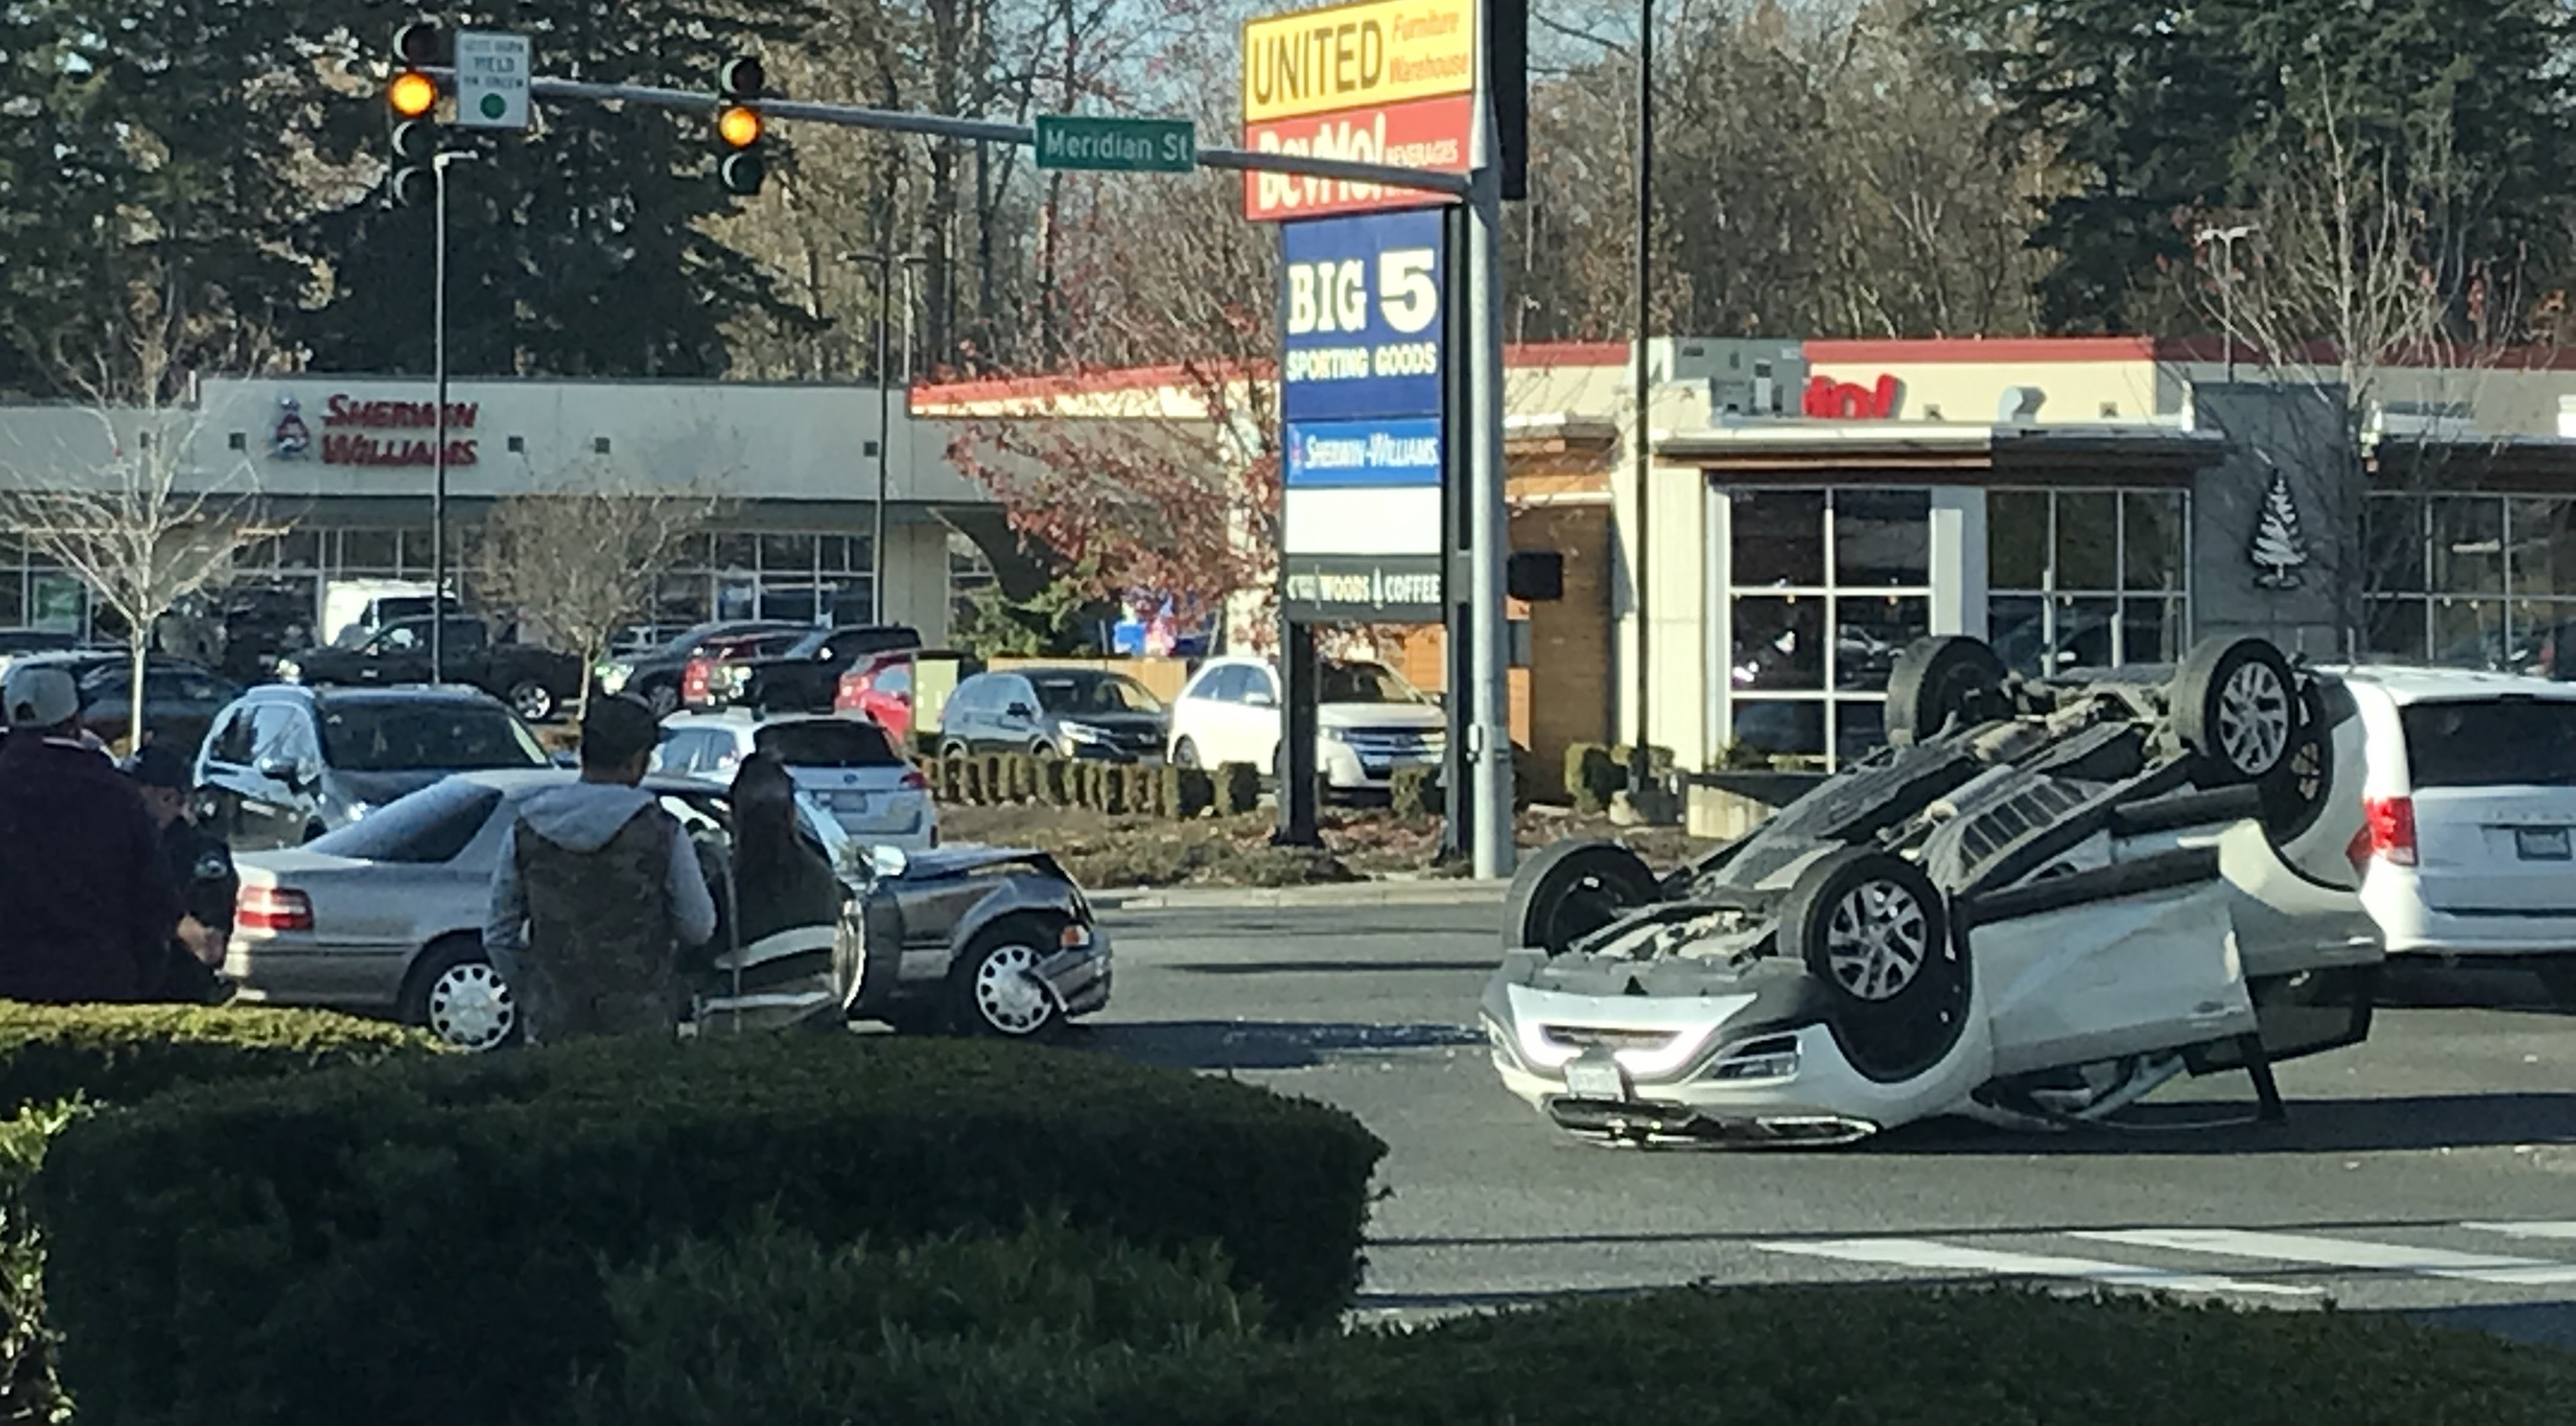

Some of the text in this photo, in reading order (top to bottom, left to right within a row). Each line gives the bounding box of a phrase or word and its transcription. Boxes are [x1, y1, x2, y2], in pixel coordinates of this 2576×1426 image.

[1392, 9, 1460, 43] Furniture
[1253, 19, 1383, 106] UNITED
[1389, 52, 1469, 84] Warehouse
[1045, 128, 1188, 161] Meridian St
[1288, 248, 1438, 335] BIG 5
[1287, 341, 1437, 382] SPORTING GOODS
[1320, 574, 1369, 602] WOODS
[1385, 574, 1441, 603] COFFEE
